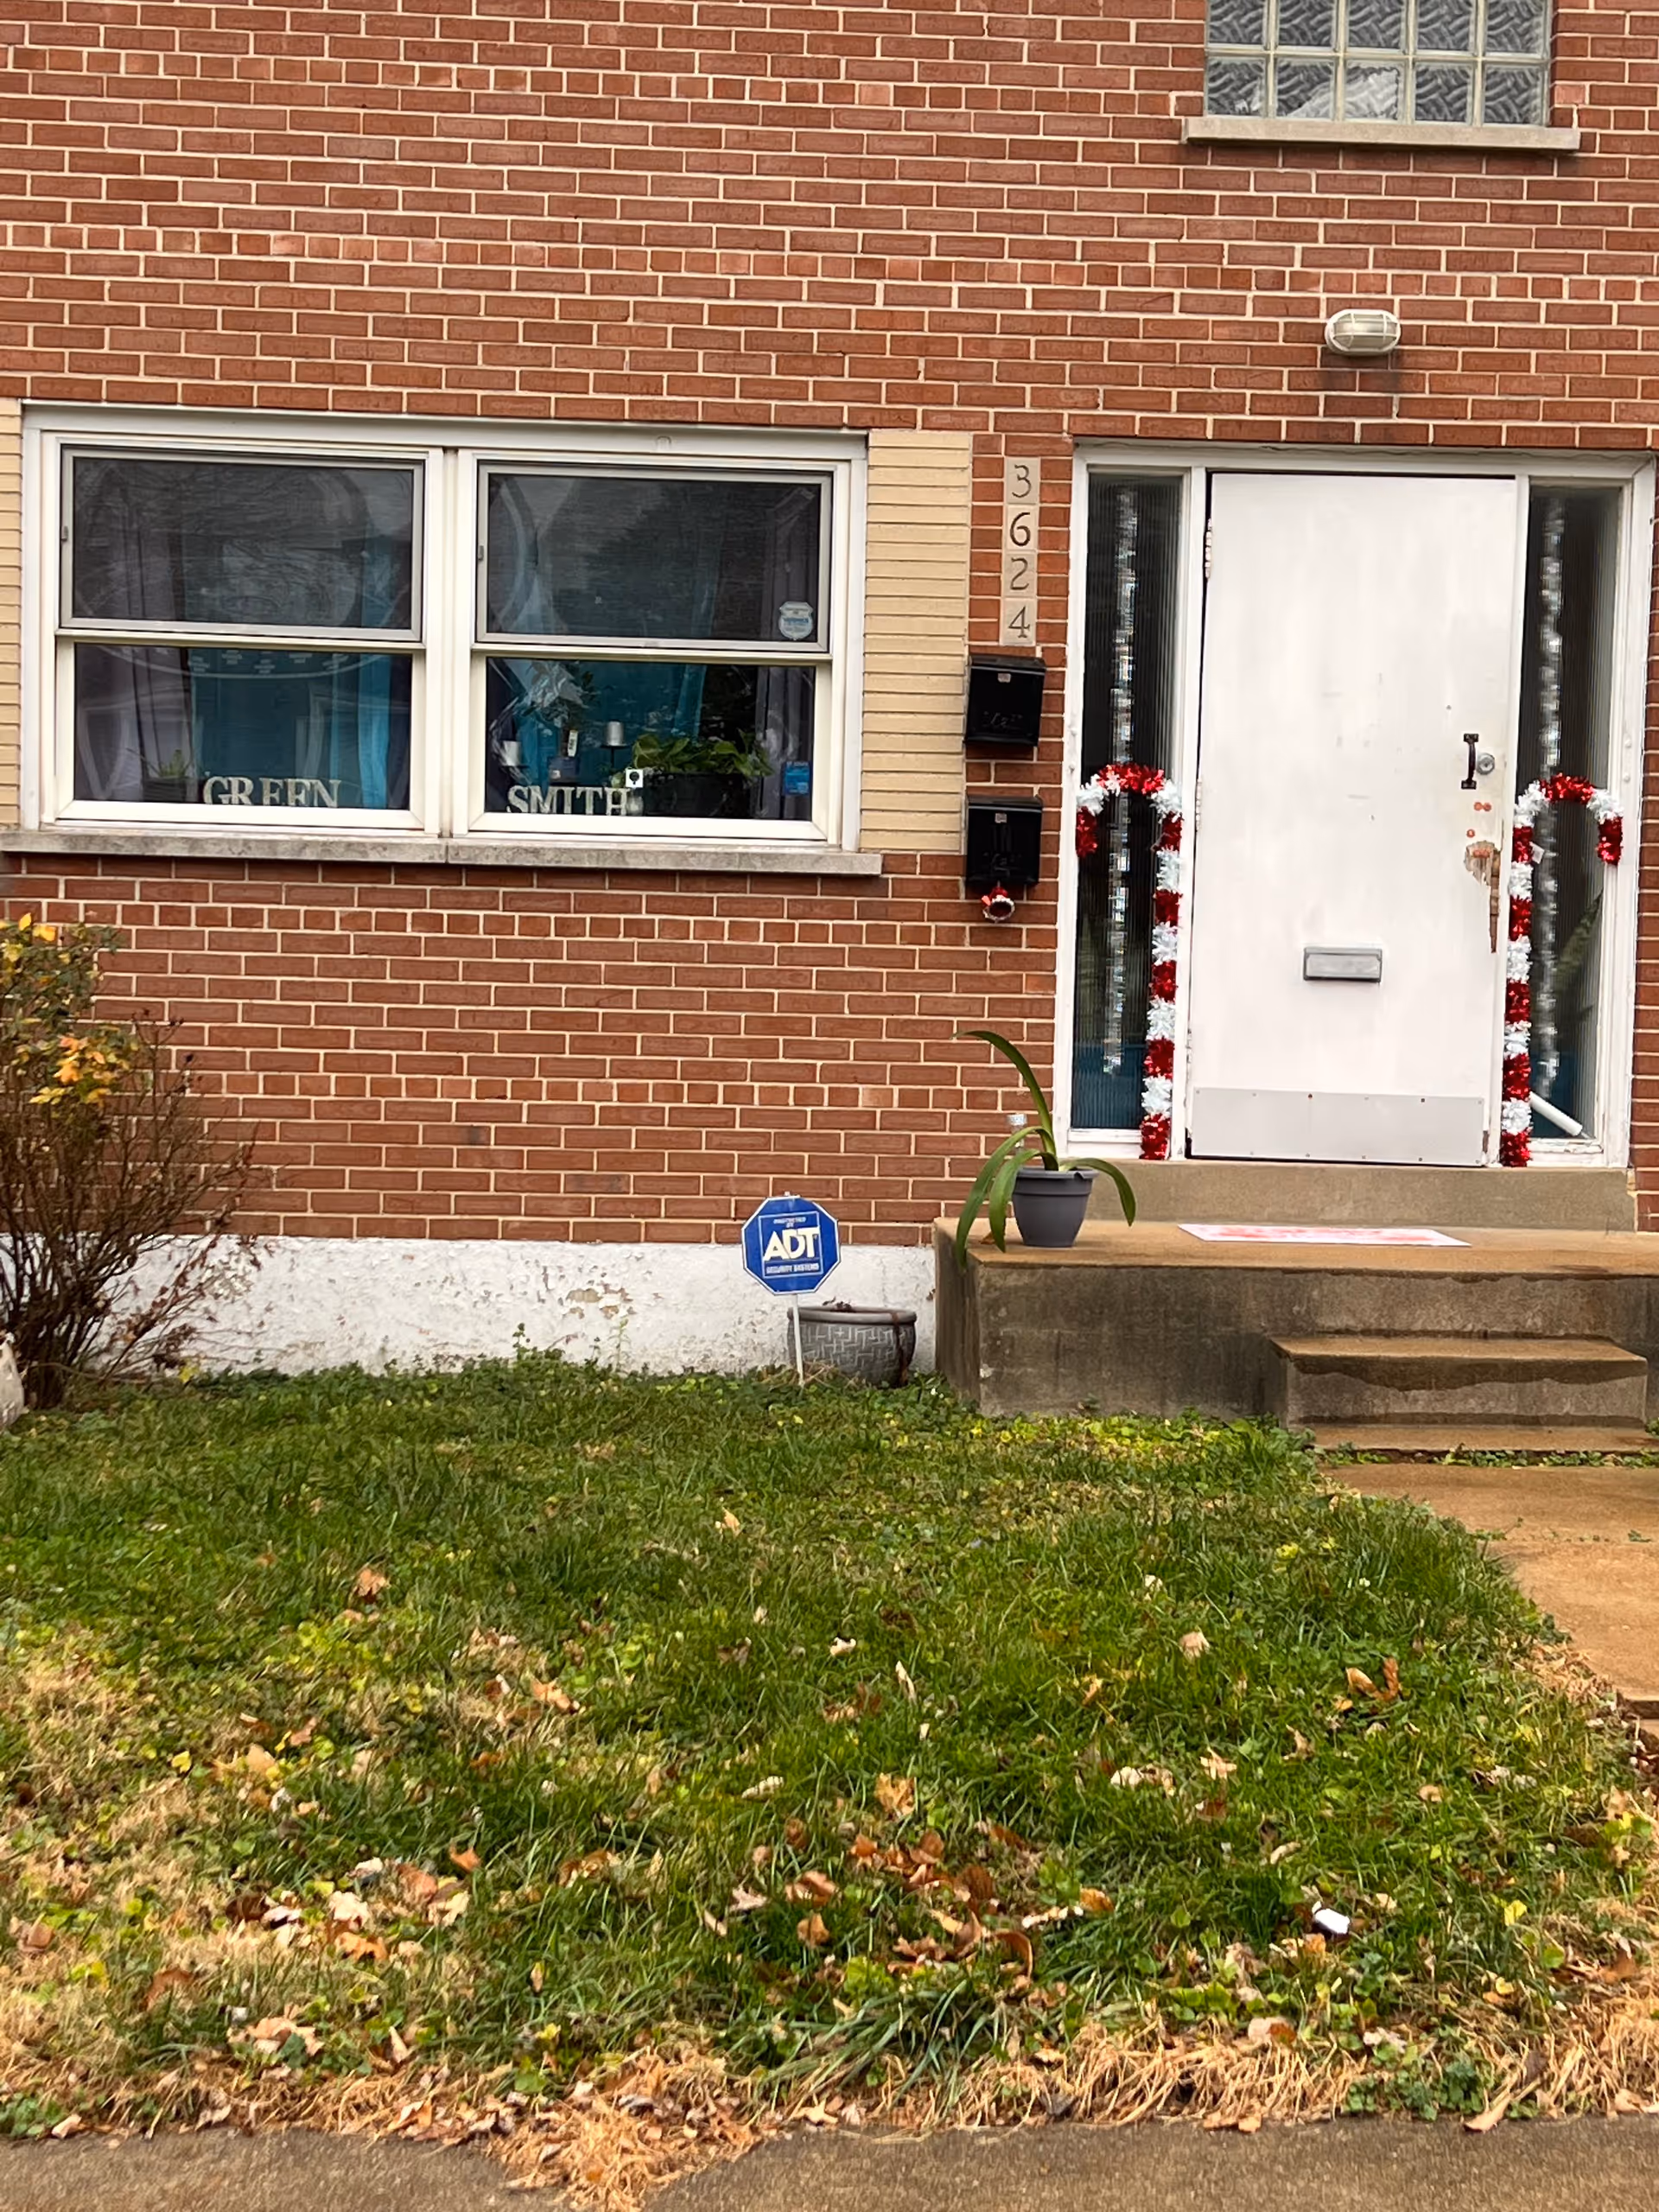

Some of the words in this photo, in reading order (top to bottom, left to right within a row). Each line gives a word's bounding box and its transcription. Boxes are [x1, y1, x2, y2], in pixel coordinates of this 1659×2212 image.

[1007, 464, 1032, 639] 3624
[202, 776, 342, 808] GREEN
[506, 785, 631, 816] SMITH
[763, 1226, 820, 1262] ADT
